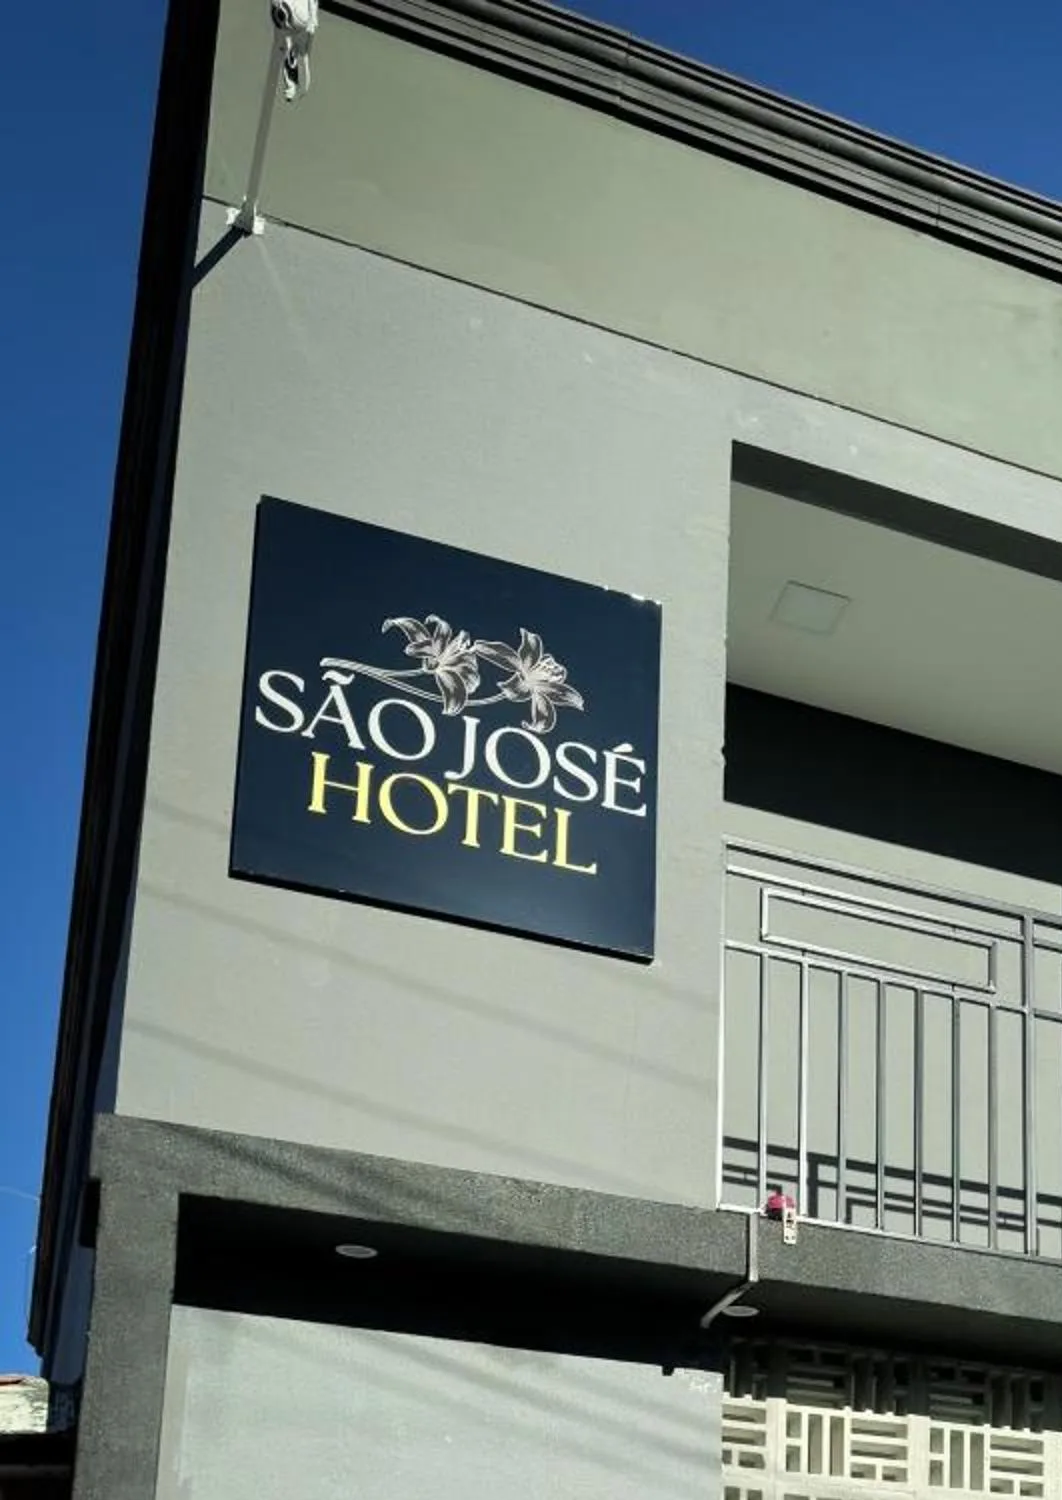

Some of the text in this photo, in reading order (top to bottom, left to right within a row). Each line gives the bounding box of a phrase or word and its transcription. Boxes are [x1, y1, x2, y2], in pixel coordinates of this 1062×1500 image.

[255, 669, 647, 817] SÃO JOSÉ
[307, 752, 597, 875] HOTEL
